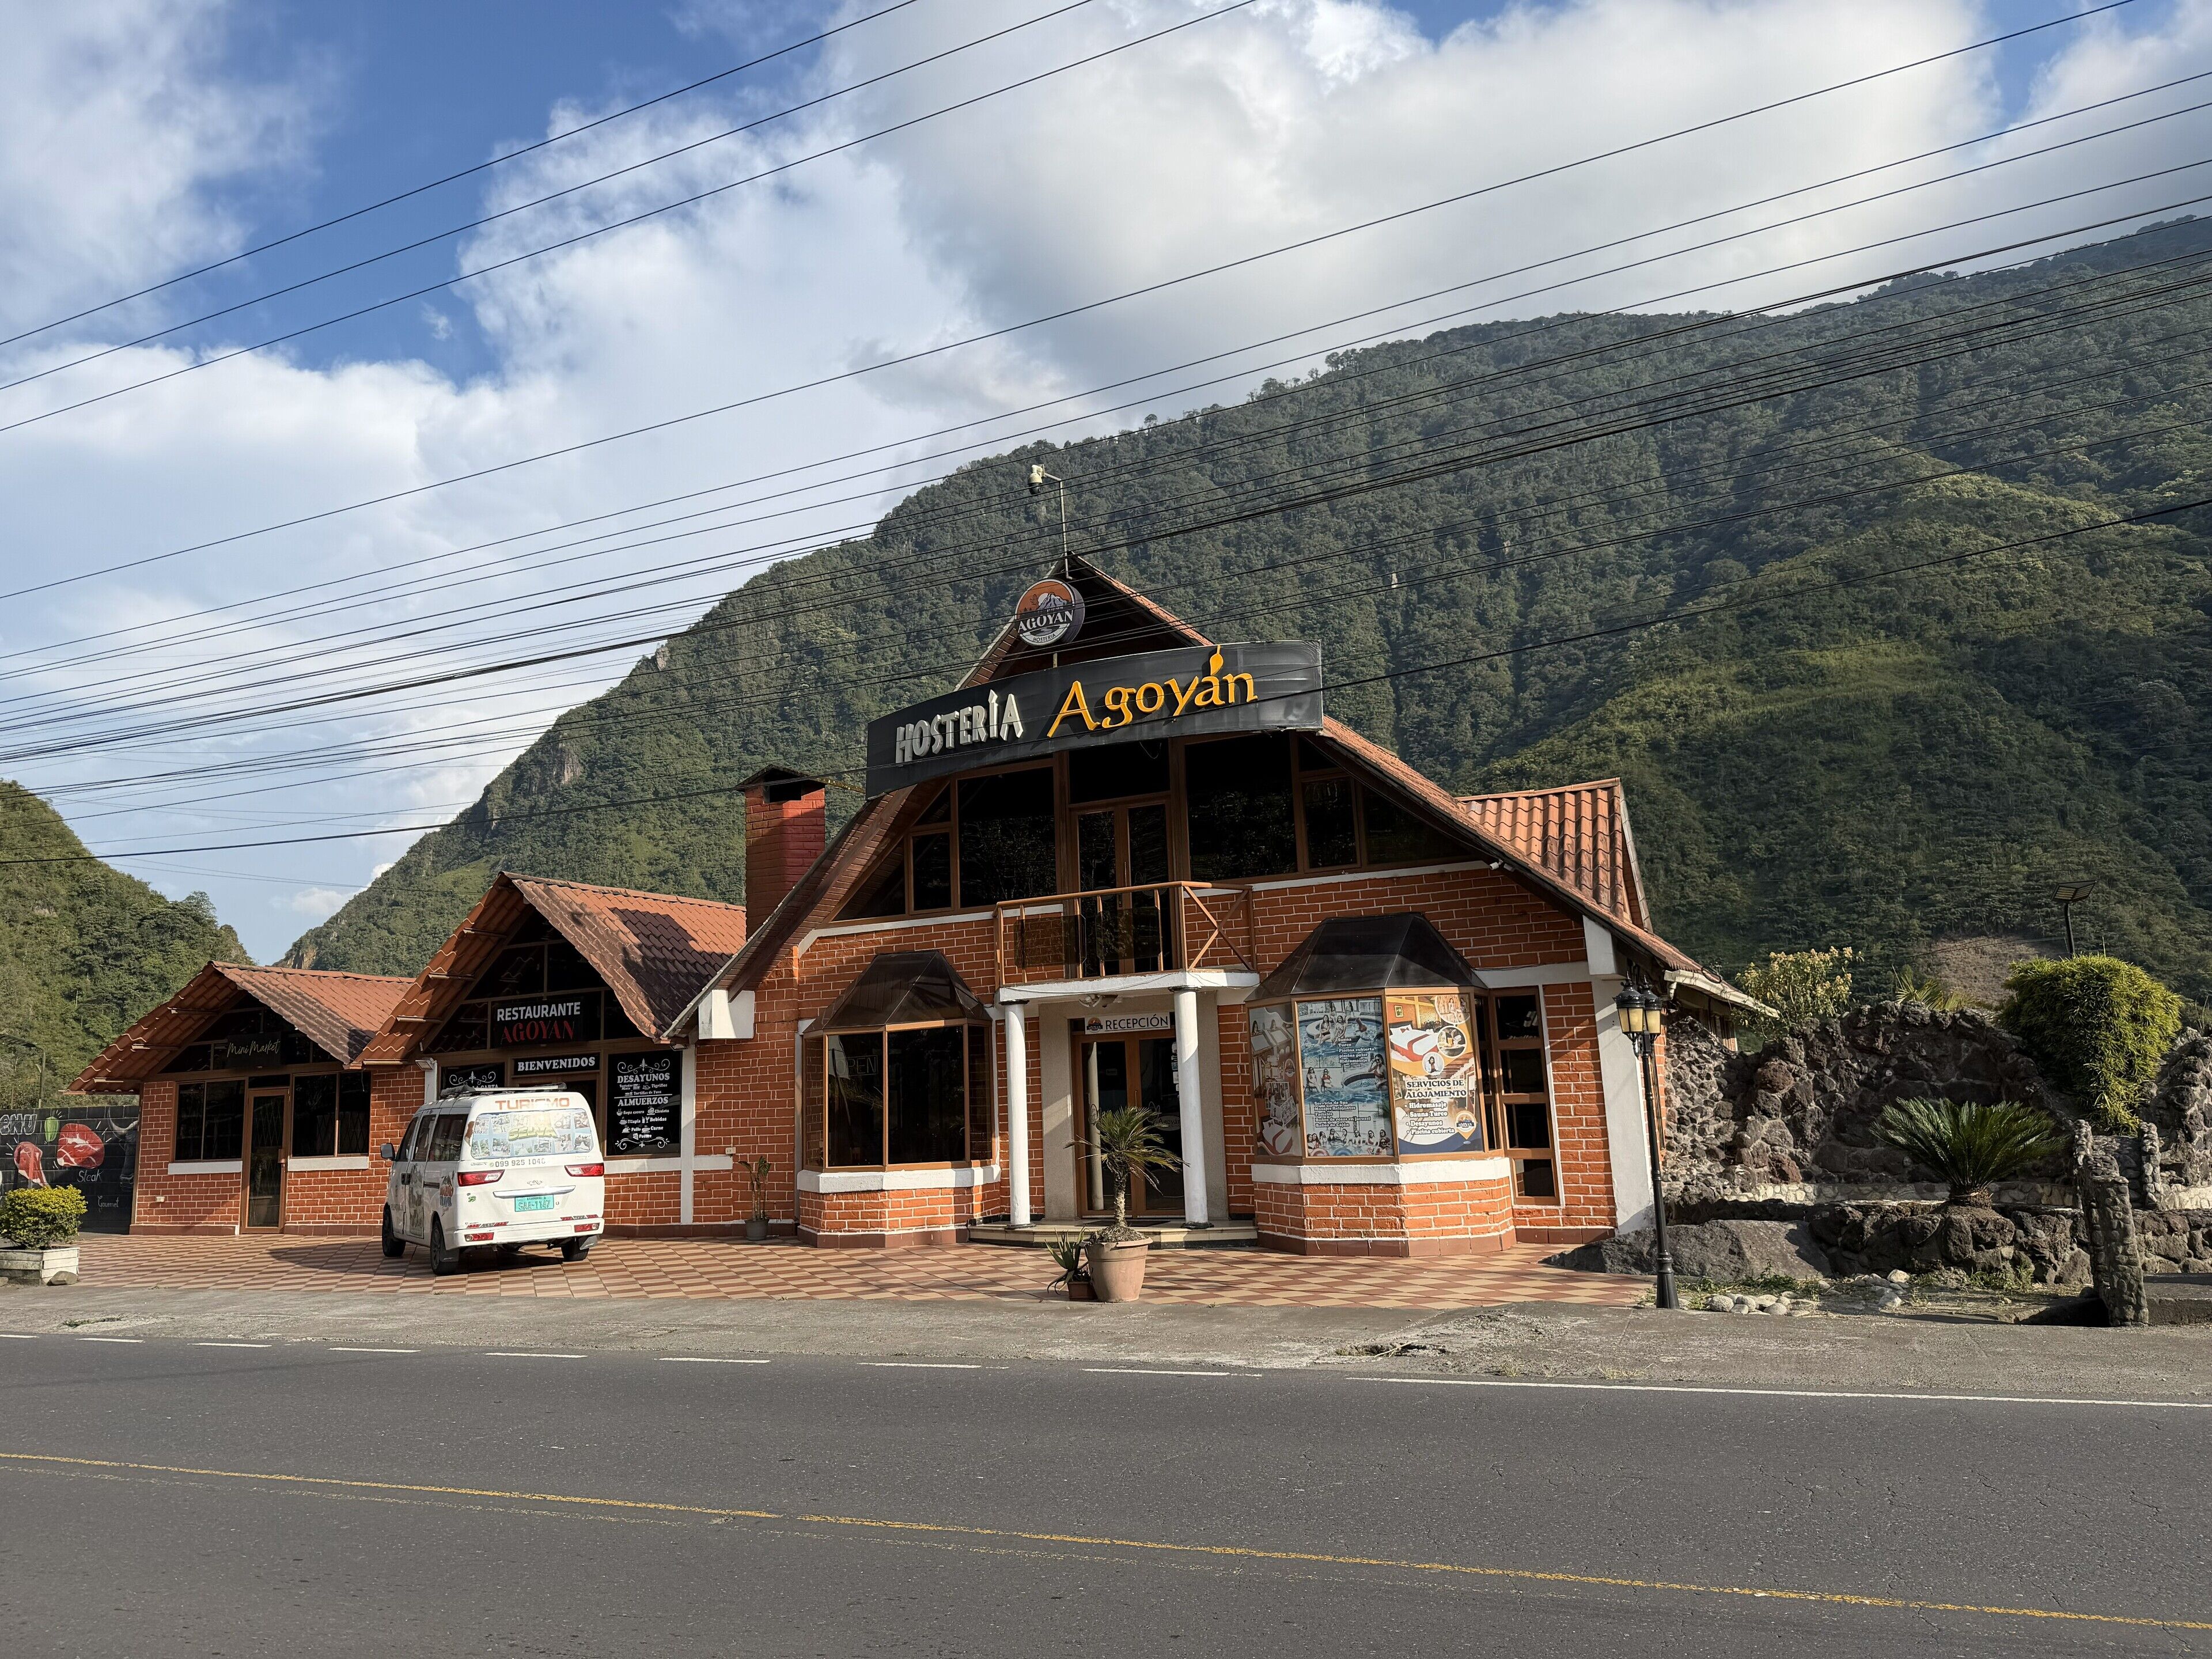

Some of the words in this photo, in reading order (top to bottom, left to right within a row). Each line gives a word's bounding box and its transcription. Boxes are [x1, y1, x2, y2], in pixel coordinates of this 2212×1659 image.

[1017, 609, 1073, 633] AGOYAN
[497, 1002, 581, 1021] RESTAURANTE
[1105, 1014, 1168, 1029] RECEPCIÓN
[501, 1020, 575, 1045] AGOYAN
[227, 1042, 249, 1058] Mini
[249, 1039, 281, 1056] Market
[517, 1056, 596, 1071] BIENVENIDOS
[618, 1073, 670, 1083] DESAYUNOS
[618, 1097, 669, 1106] ALMUERZOS
